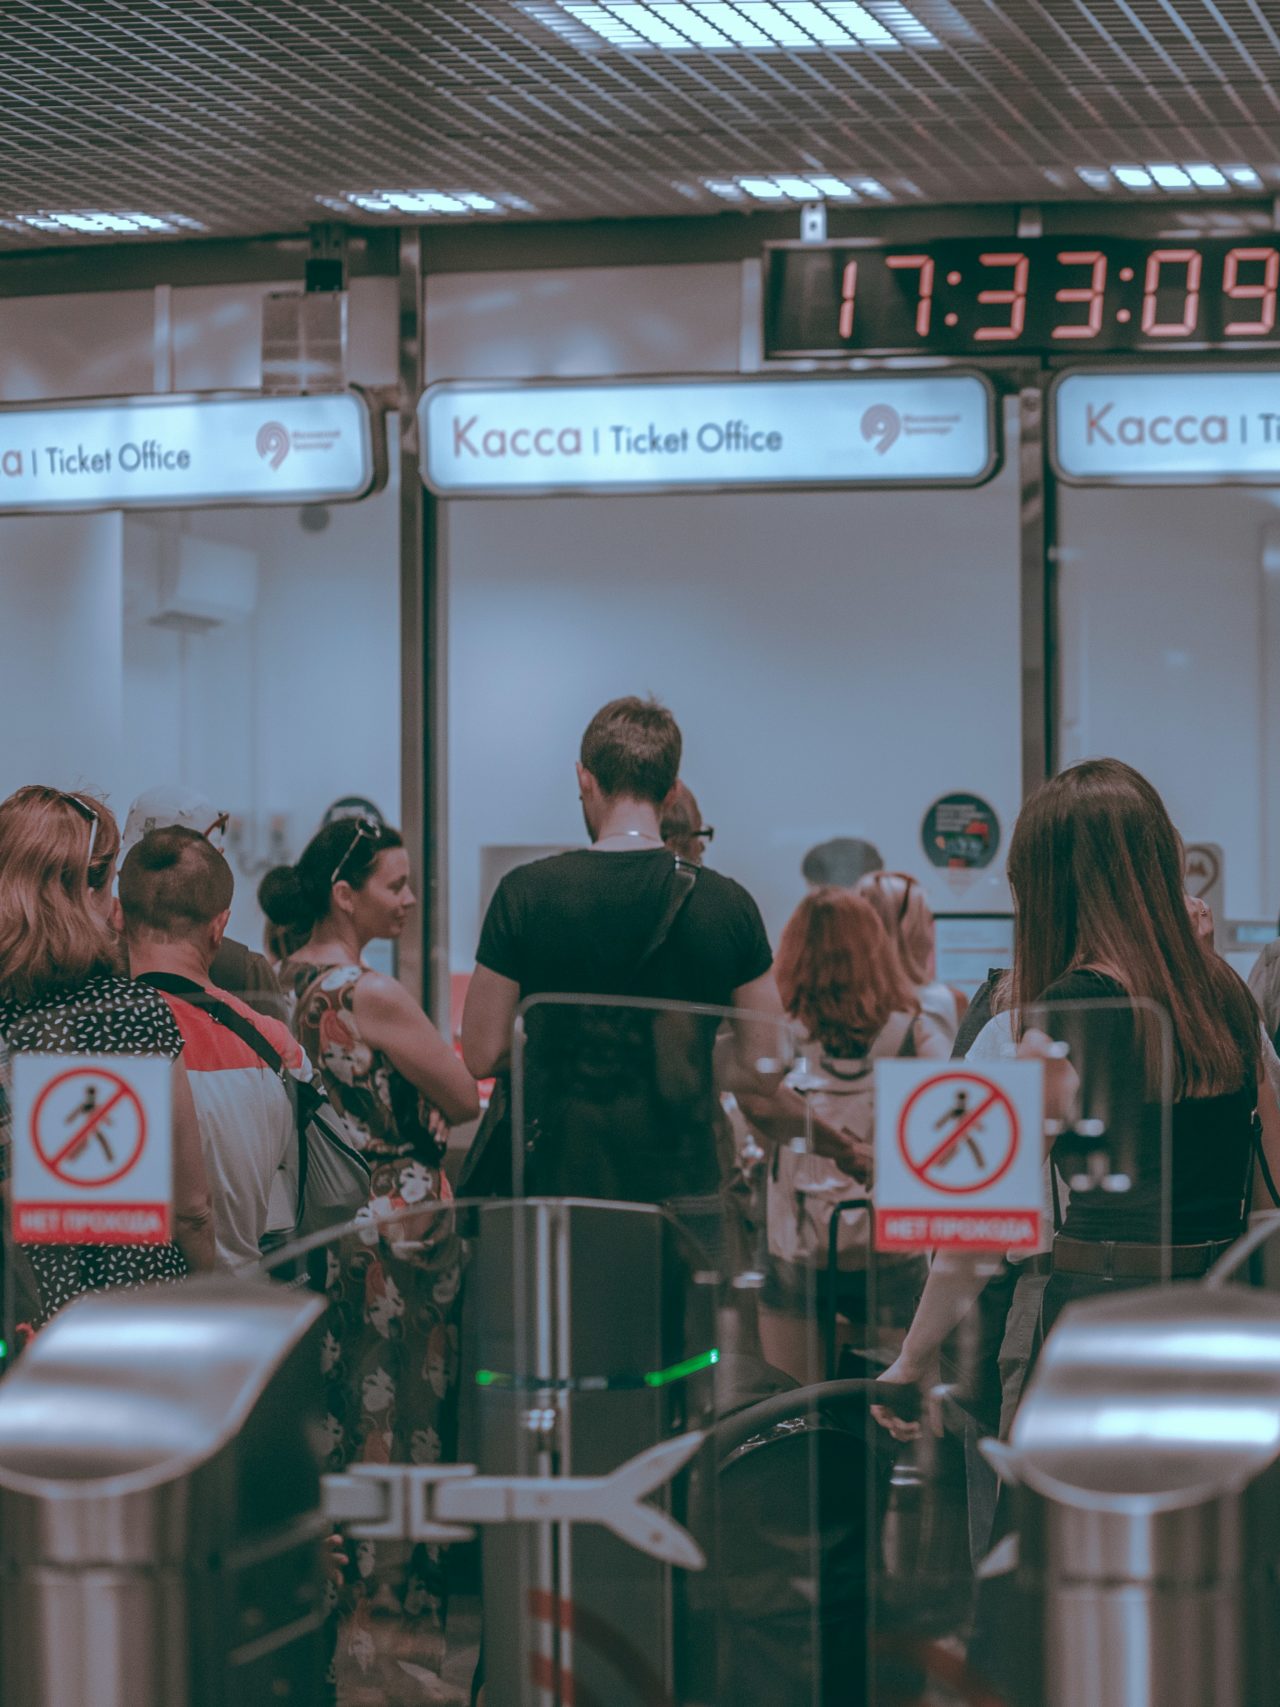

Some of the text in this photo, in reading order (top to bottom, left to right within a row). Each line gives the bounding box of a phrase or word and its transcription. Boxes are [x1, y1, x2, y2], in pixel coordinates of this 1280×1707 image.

[839, 247, 1280, 341] 17:33:09
[453, 415, 783, 458] Касса Ticket Office
[1085, 401, 1228, 446] Касса
[45, 444, 112, 475] Ticket
[118, 439, 191, 472] Office
